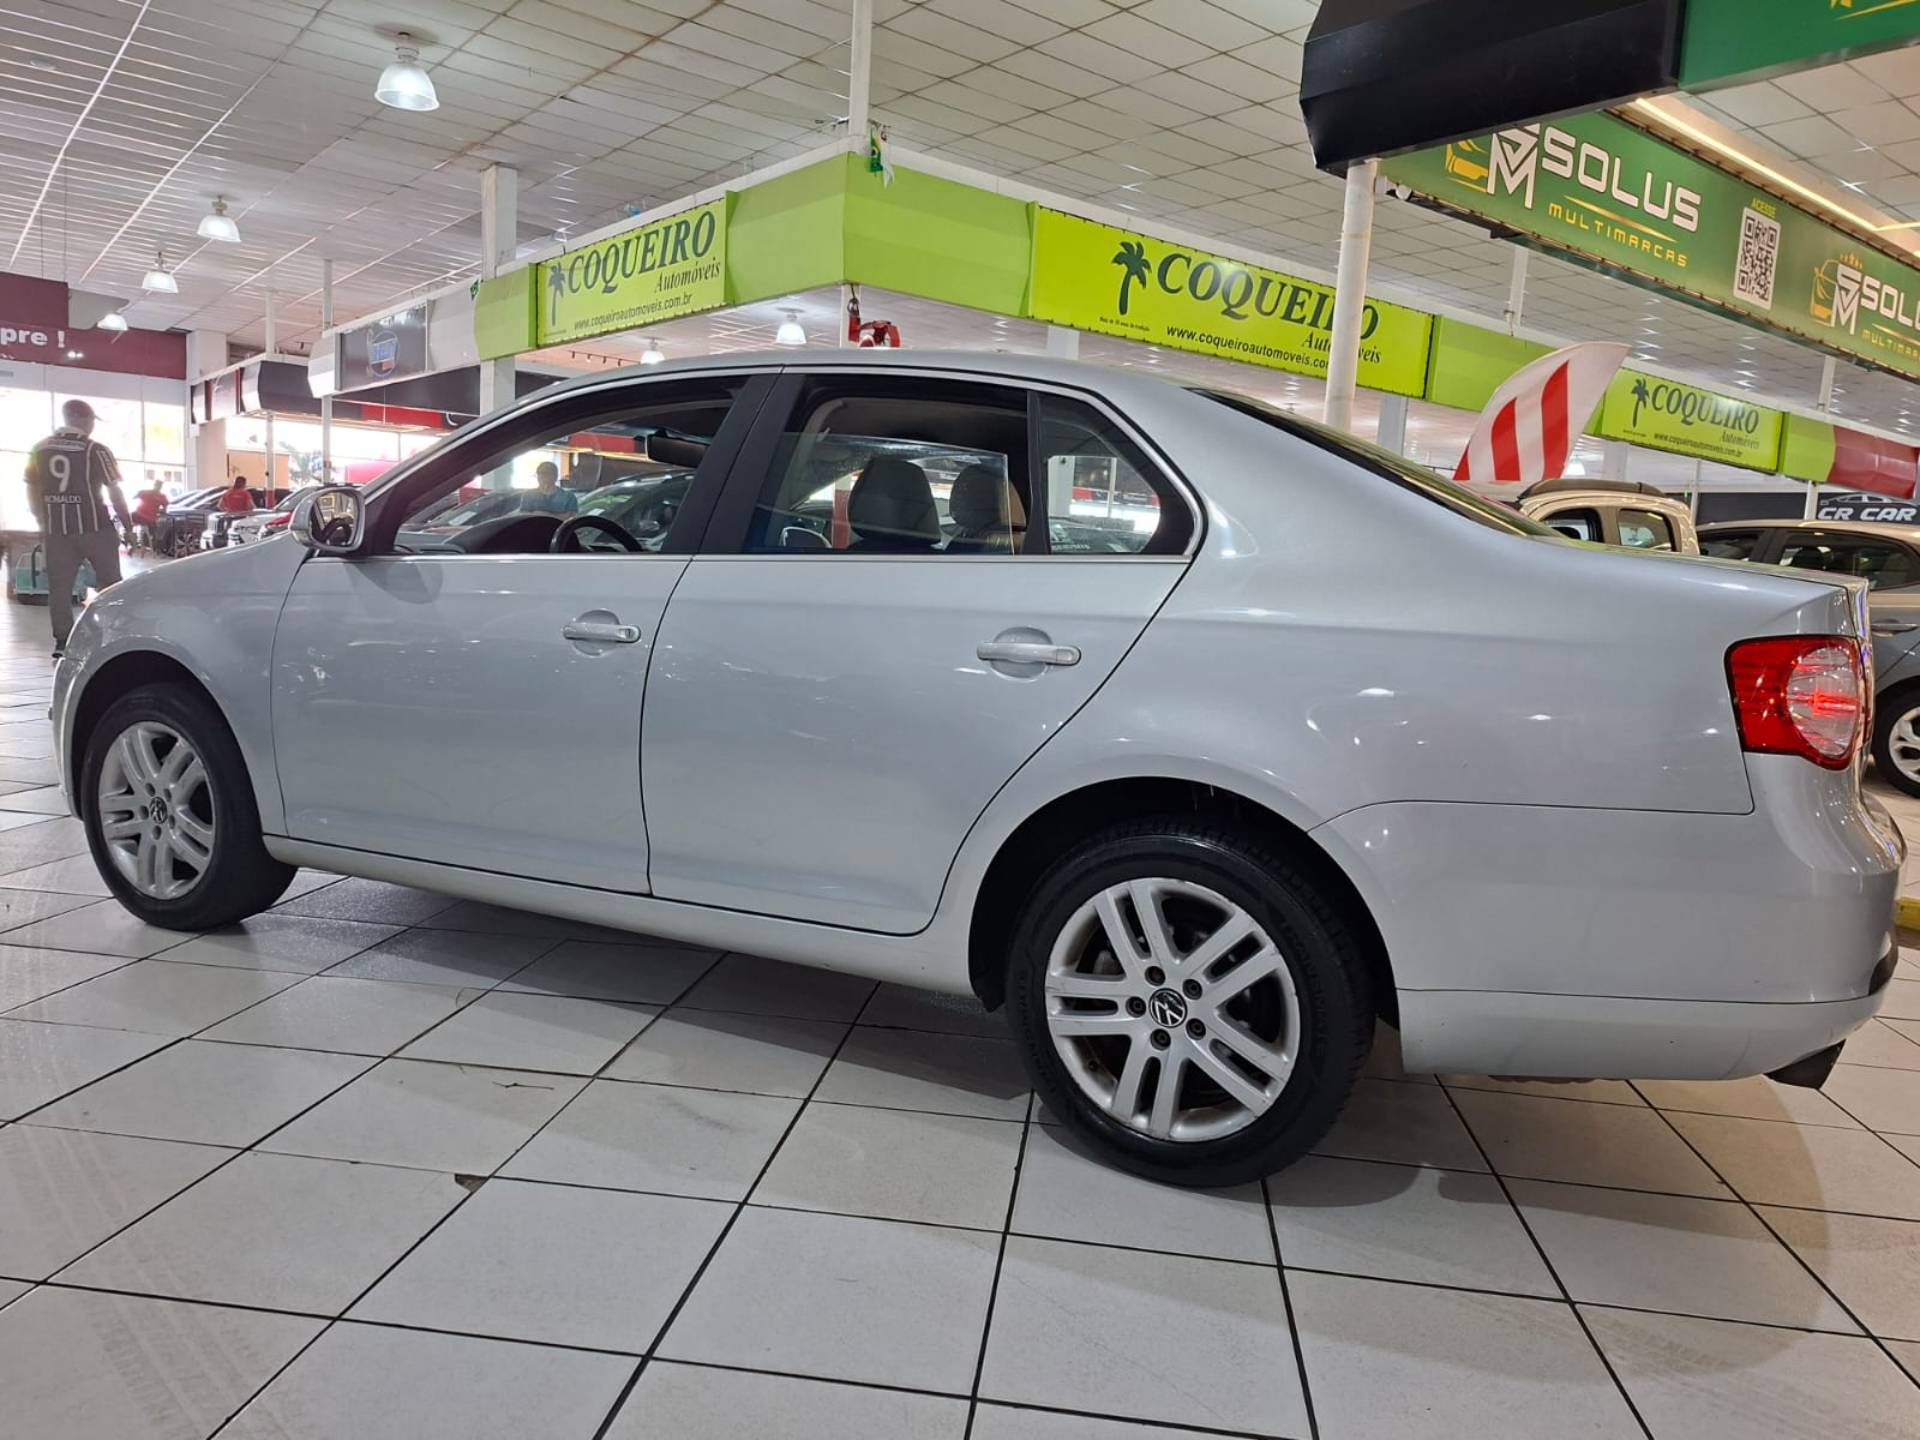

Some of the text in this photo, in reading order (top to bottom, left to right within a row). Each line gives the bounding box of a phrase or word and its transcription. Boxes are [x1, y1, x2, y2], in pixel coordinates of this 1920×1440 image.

[1542, 126, 1701, 233] SOLUS
[568, 211, 716, 294] COQUEIRO
[1548, 202, 1687, 268] MULTIMARCAS
[654, 256, 722, 293] Automóveis
[1157, 252, 1379, 340] COQUEIO
[1166, 325, 1329, 369] www.coqueiroautomoveis.co
[1651, 384, 1759, 434] COQUEIRO
[49, 454, 70, 493] 9
[44, 495, 82, 504] RONALDO
[1818, 507, 1917, 521] CR CAR
